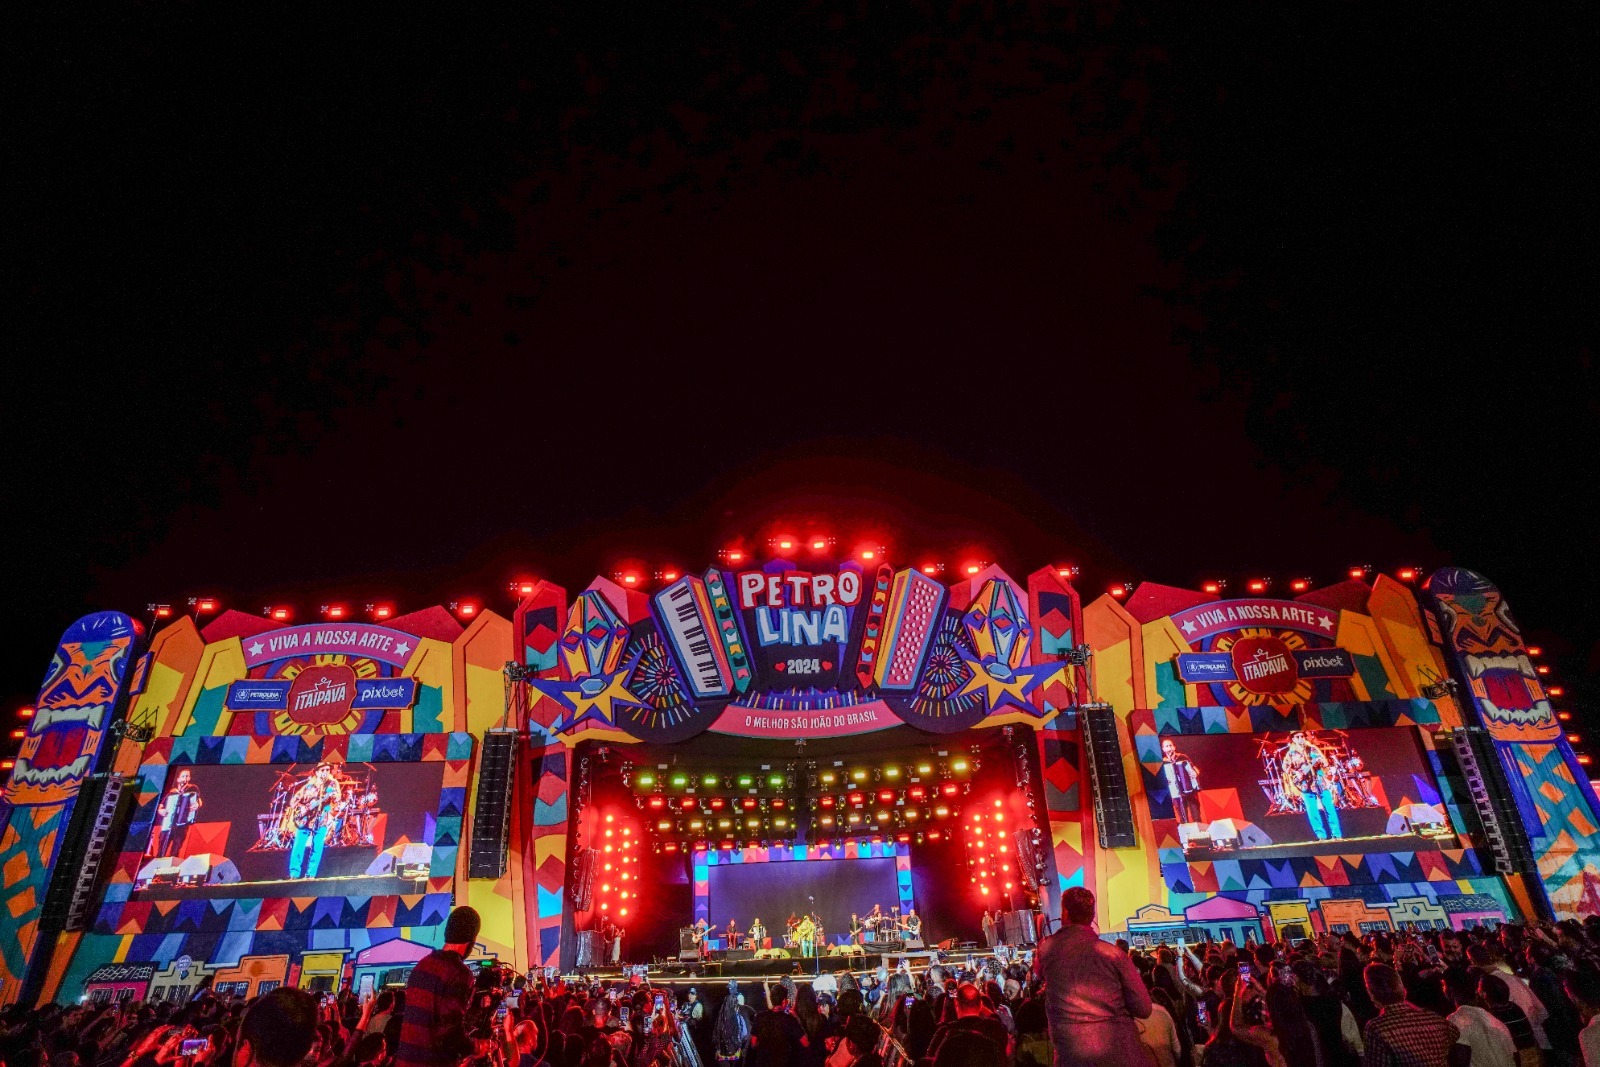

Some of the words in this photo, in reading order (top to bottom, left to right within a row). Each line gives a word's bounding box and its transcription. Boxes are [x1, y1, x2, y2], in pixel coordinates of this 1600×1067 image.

[739, 570, 861, 608] PETRO
[757, 605, 847, 646] LINA
[1195, 608, 1227, 628] VIVA
[1228, 607, 1237, 621] A
[1238, 605, 1281, 621] NOSSA
[1282, 607, 1315, 625] ARTE
[269, 635, 299, 652] VIVA
[302, 632, 311, 646] A
[314, 630, 357, 645] NOSSA
[357, 631, 394, 652] ARTE
[787, 658, 820, 674] 2024
[1243, 657, 1289, 681] ITAIPAVA
[1303, 655, 1344, 671] pixbet
[294, 686, 347, 711] ITAIPAVA
[361, 685, 404, 702] pixbet
[745, 715, 752, 727] O
[753, 716, 790, 729] MELHOR
[791, 716, 808, 729] SÃO
[810, 715, 831, 729] JOÃO
[833, 715, 845, 727] DO
[847, 710, 878, 725] BRASIL
